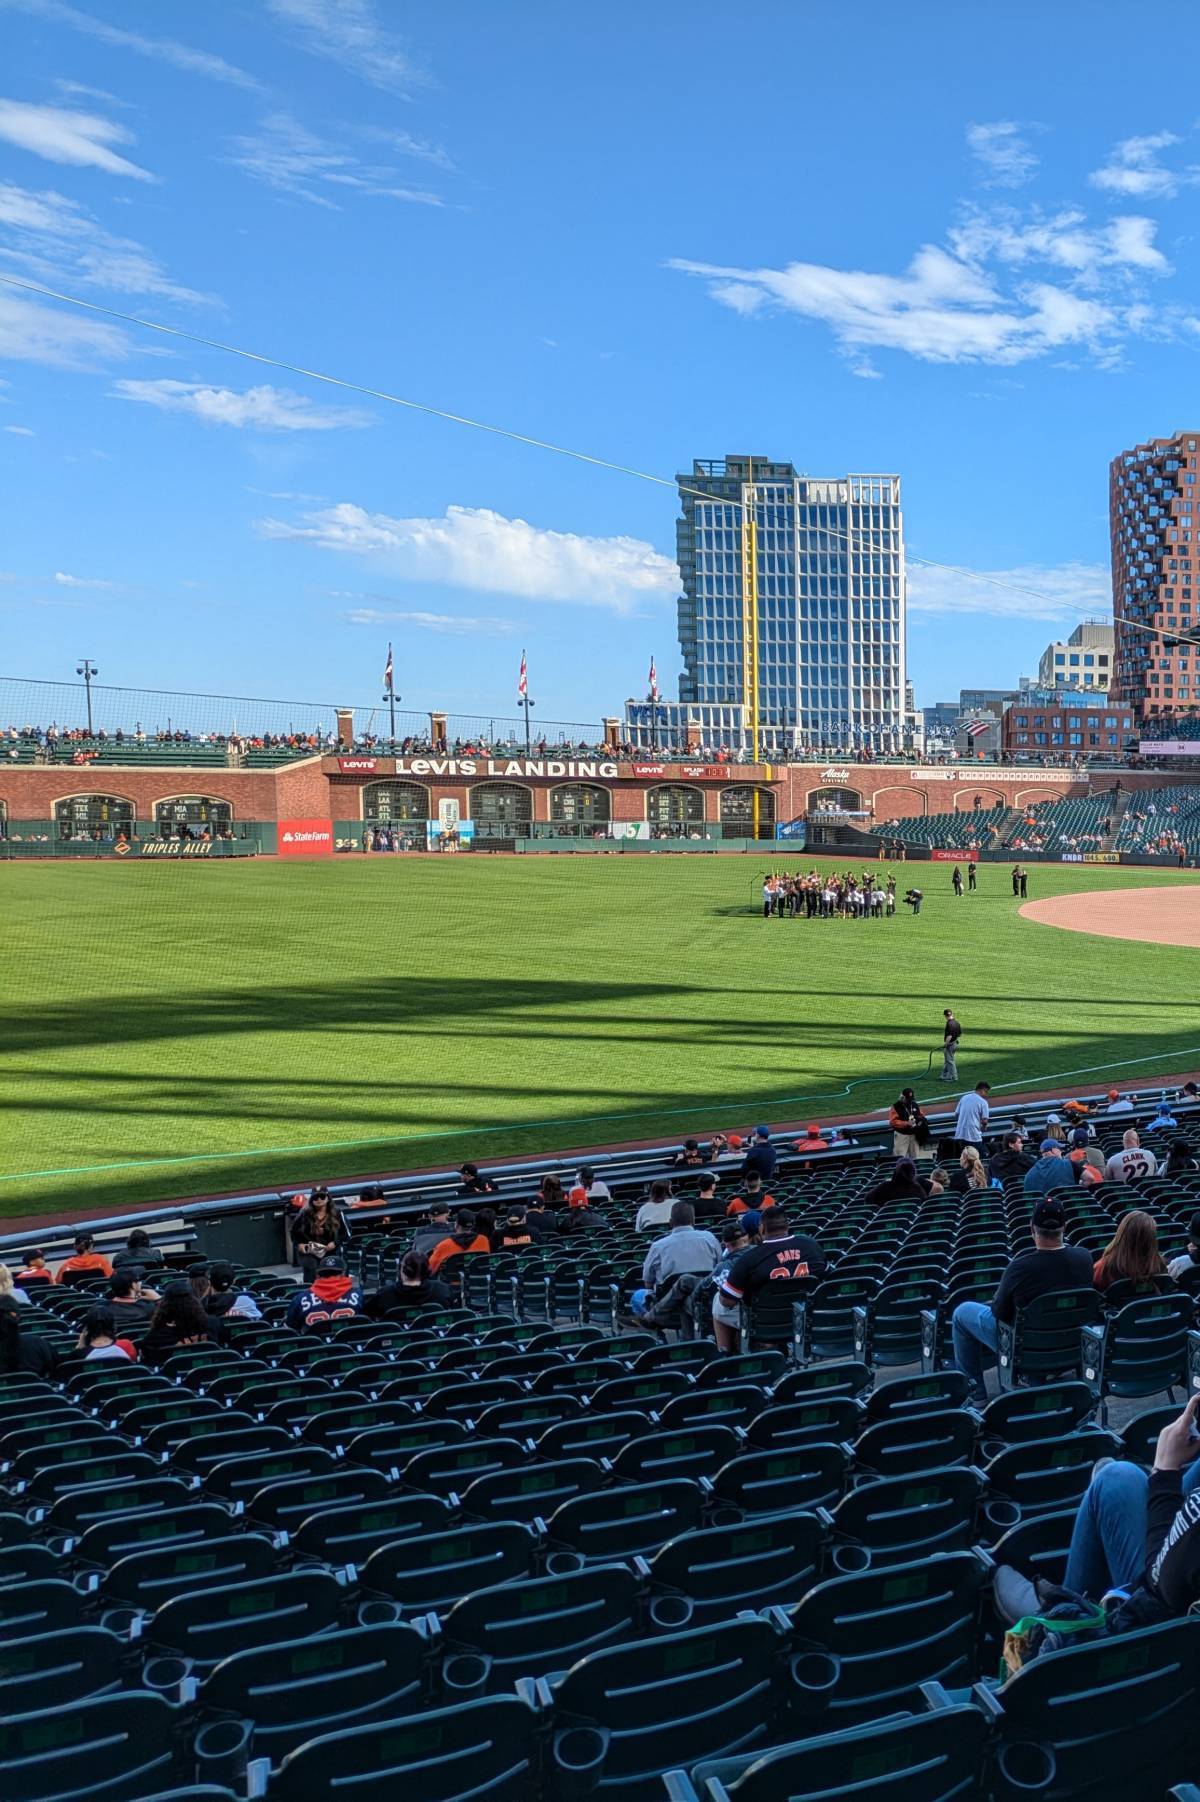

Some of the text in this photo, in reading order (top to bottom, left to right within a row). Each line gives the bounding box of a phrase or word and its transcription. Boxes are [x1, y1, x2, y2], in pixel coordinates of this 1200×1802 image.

[822, 721, 958, 737] BANK OF AMERICA
[487, 760, 618, 777] LANDING
[820, 768, 850, 779] Alaska
[74, 804, 89, 812] TEX
[174, 805, 187, 813] MIA
[75, 812, 89, 820] MIL
[176, 813, 186, 821] KC
[378, 812, 391, 820] STL
[142, 842, 213, 854] TRIPLES ALLEY
[937, 852, 972, 860] ORACLE
[1062, 853, 1083, 862] KNBR
[1122, 1152, 1146, 1164] CLARK
[776, 1249, 801, 1264] MAYS
